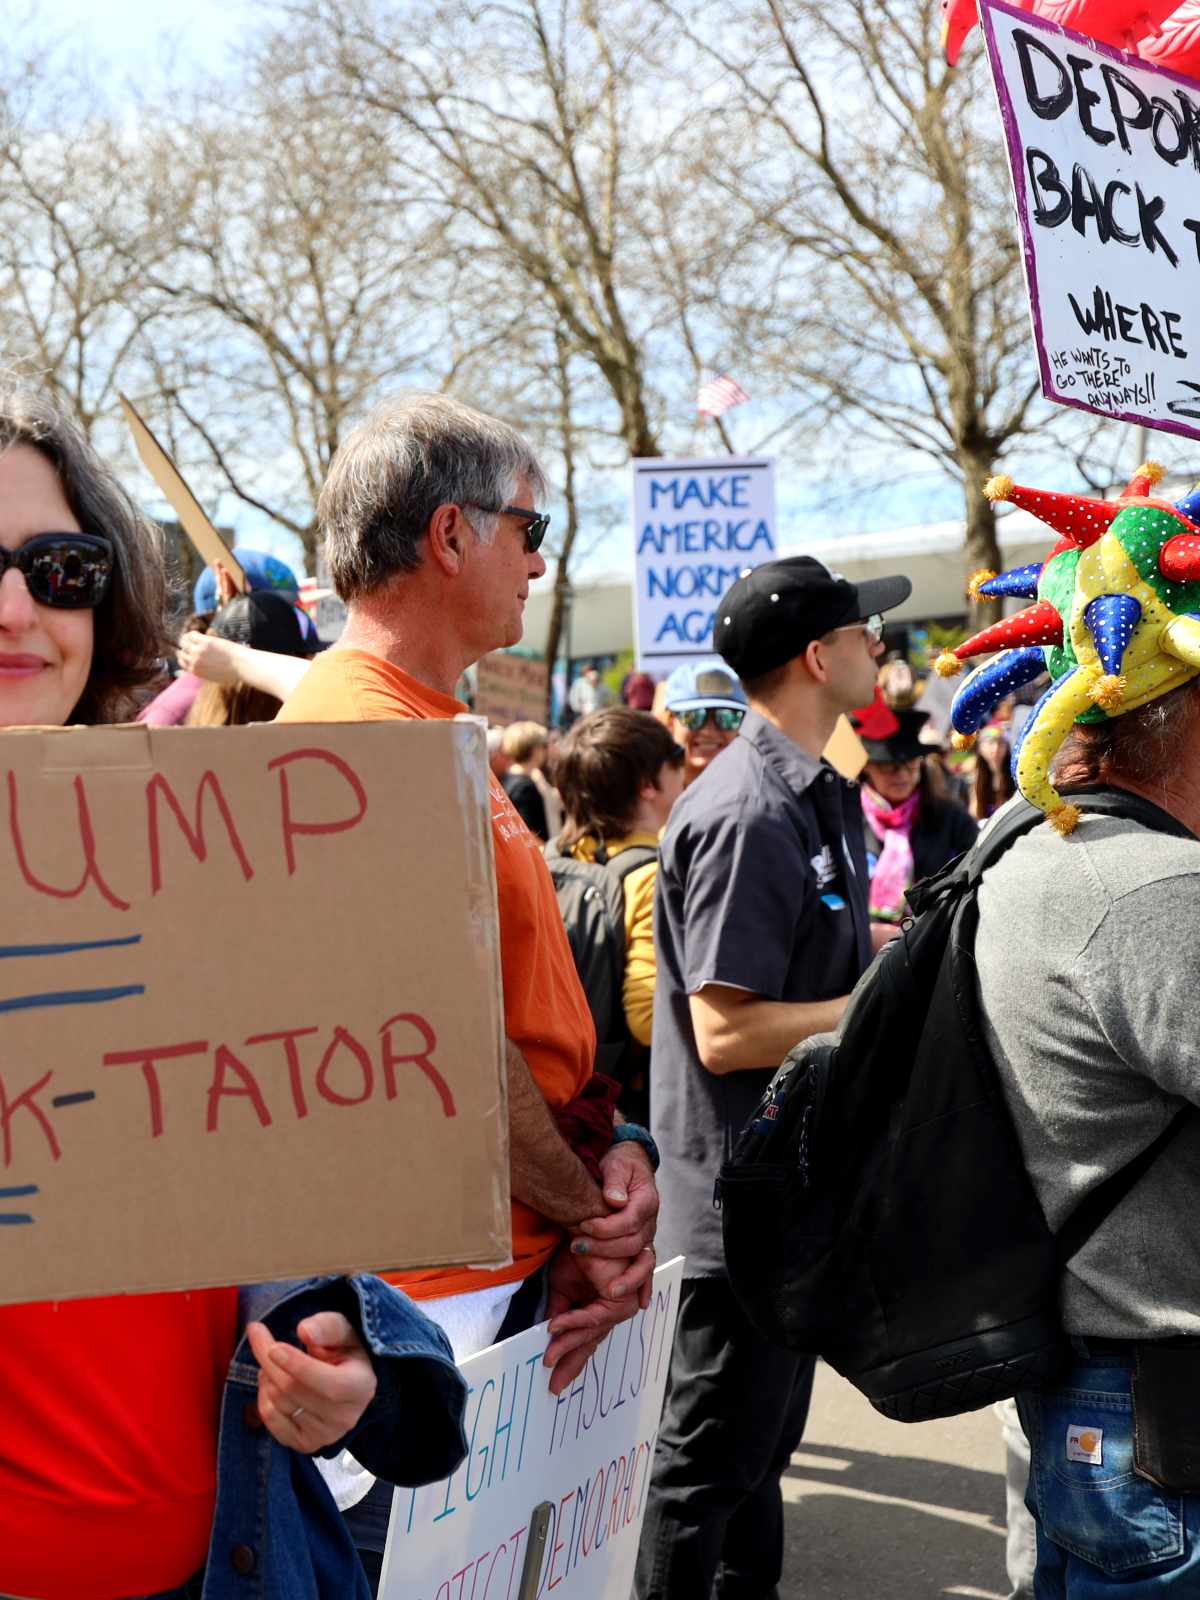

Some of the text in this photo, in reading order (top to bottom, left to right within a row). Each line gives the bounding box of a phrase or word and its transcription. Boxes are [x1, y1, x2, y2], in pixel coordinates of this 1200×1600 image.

[1026, 146, 1179, 269] BACK
[1068, 286, 1188, 359] WHERE
[1051, 351, 1068, 369] HE
[1070, 347, 1110, 370] WANTS
[1056, 368, 1121, 389] GO THERE
[650, 474, 751, 509] MAKE
[637, 518, 774, 554] AMERICA
[647, 563, 762, 598] NORM
[1070, 1436, 1079, 1444] FR
